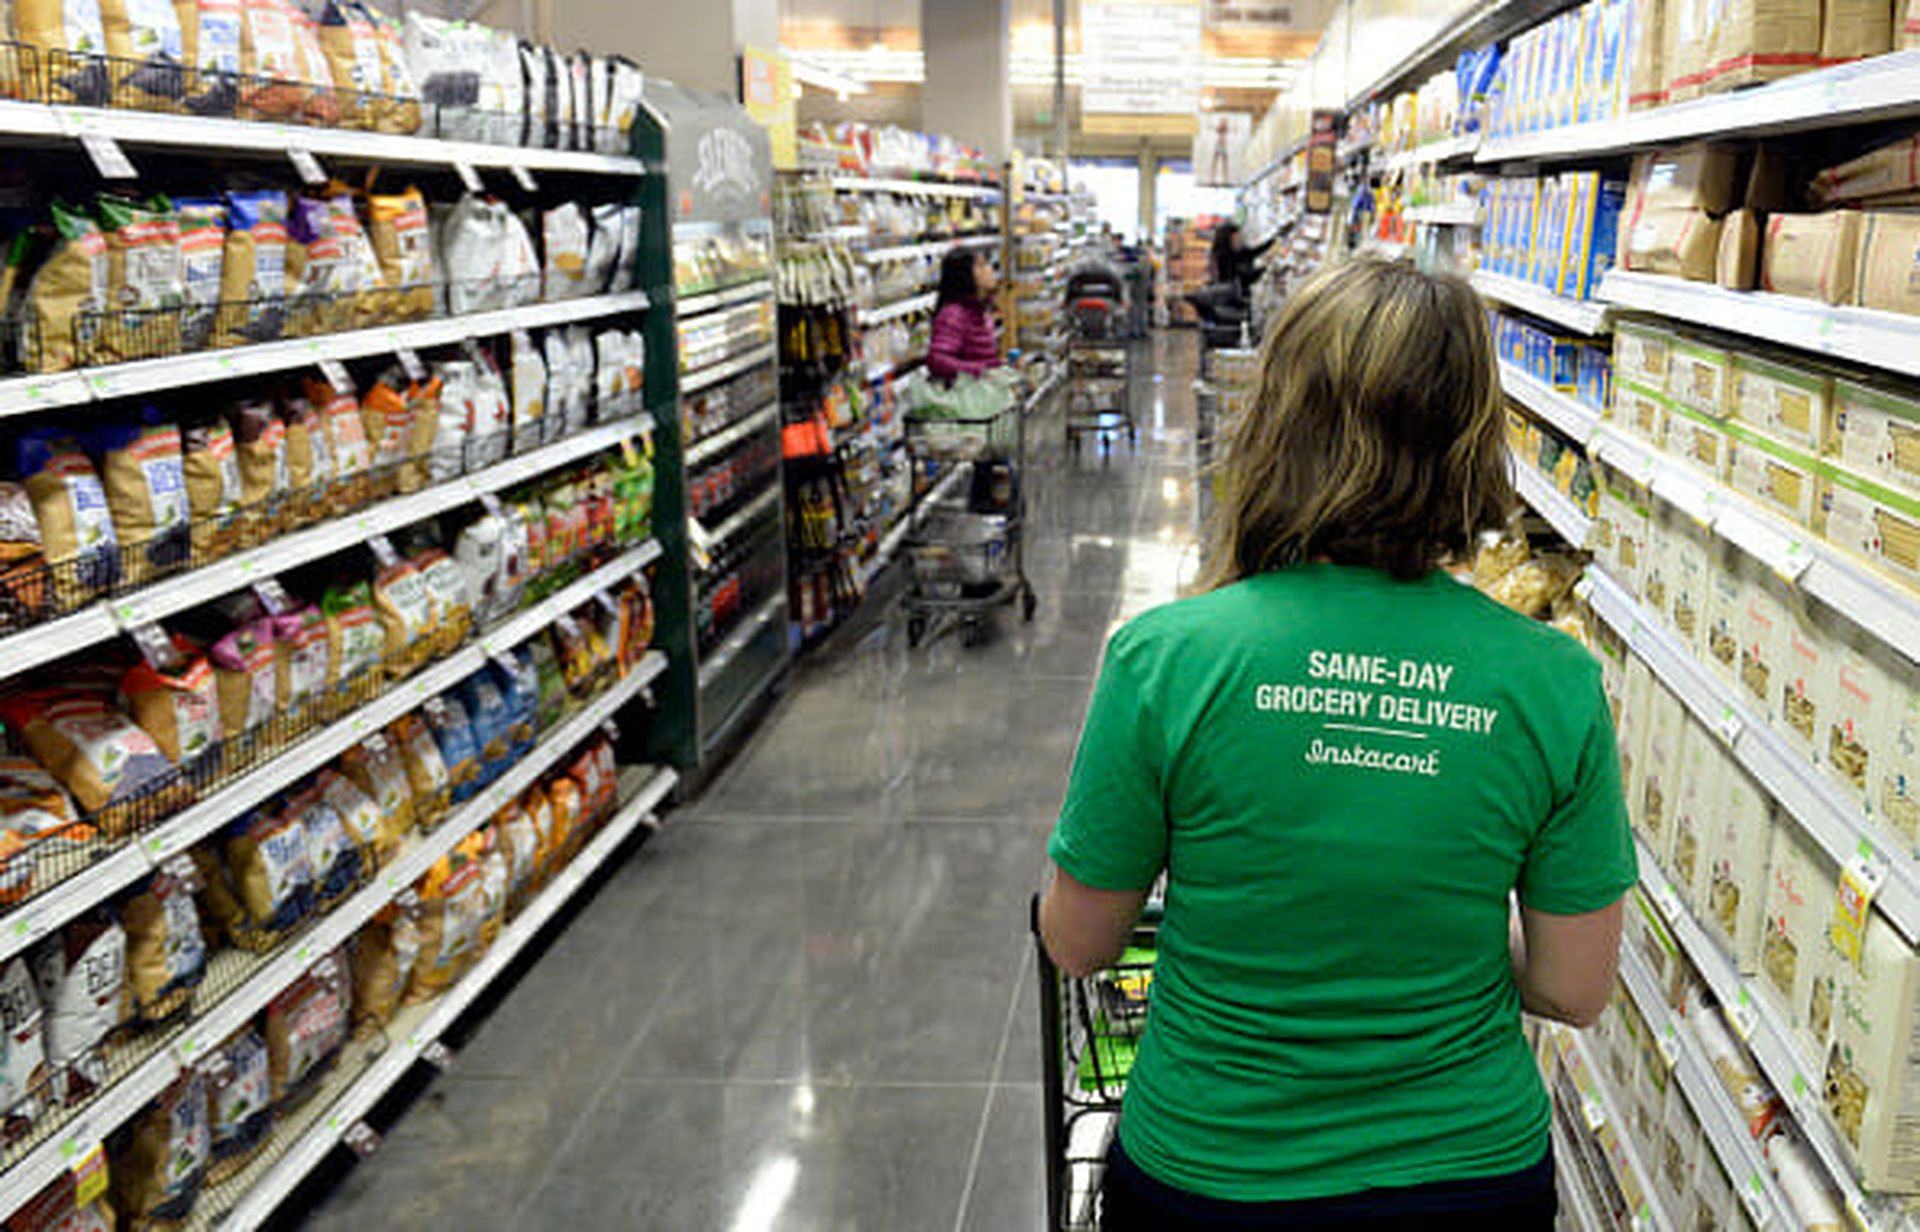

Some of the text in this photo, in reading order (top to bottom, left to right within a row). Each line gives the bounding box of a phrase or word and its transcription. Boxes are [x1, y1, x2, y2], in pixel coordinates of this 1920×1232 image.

[1308, 650, 1453, 692] SAME-DAY
[1255, 685, 1498, 733] GROCERY DELIVERY
[1305, 739, 1440, 775] Instacart
